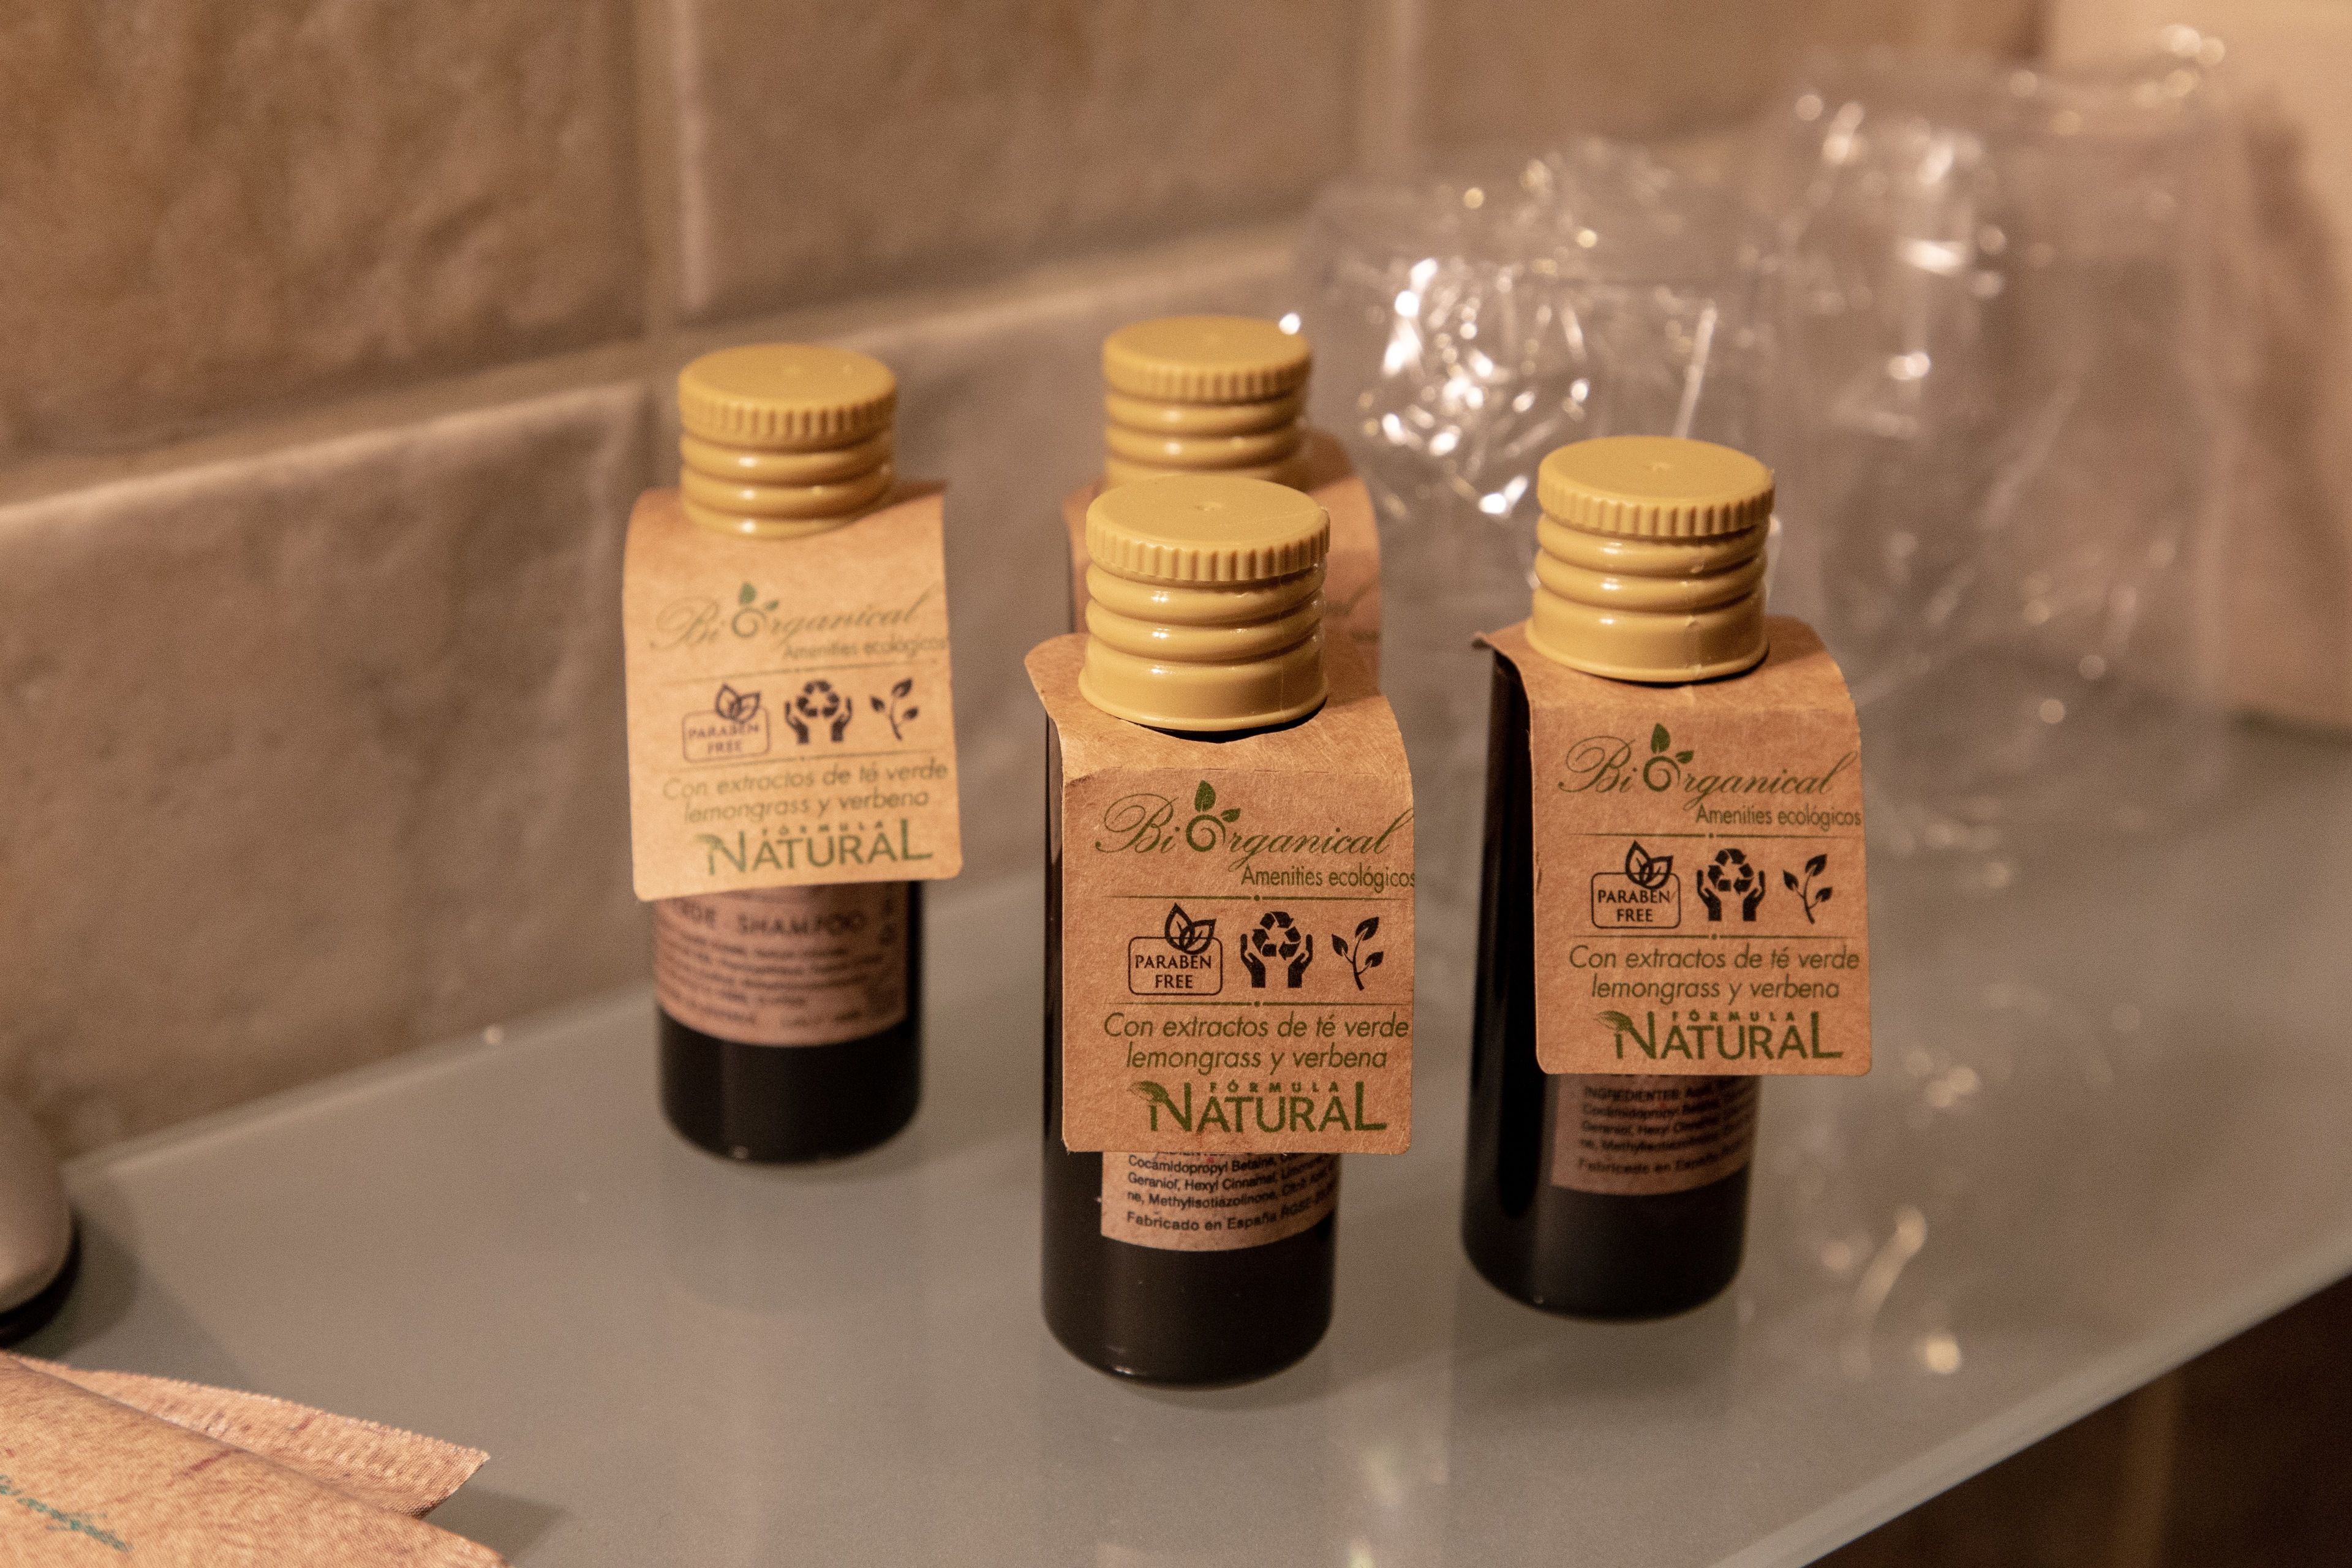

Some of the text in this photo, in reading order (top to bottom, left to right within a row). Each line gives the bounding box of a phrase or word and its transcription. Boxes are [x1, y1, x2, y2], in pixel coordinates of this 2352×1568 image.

[688, 722, 759, 739] PARABEN
[707, 740, 742, 755] FREE
[662, 757, 948, 800] Con extractos de té verde
[684, 786, 929, 824] lemongrass y verbena
[1695, 803, 1861, 832] Amenities ecológicos
[694, 818, 933, 876] NATURAL
[1241, 864, 1415, 892] Amenities ecológicos
[1597, 889, 1670, 904] PARABEN
[1616, 908, 1654, 923] FREE
[1135, 954, 1212, 970] PARABEN
[1569, 943, 1860, 969] Con extractos de té verde
[1155, 974, 1193, 989] FREE
[1591, 973, 1840, 1005] lemongrass y verbena
[1104, 1012, 1409, 1038] Con extractos de té verde
[1672, 1009, 1795, 1022] FÓRMULA
[1594, 1010, 1844, 1060] NATURAL
[1126, 1042, 1387, 1076] lemongrass y verbena
[1209, 1080, 1340, 1093] FÓRMULA
[1127, 1080, 1388, 1133] NATURAL
[1128, 1154, 1227, 1177] Cocamidopropyl
[1185, 1174, 1219, 1194] Hexyl
[1128, 1190, 1145, 1206] ne,
[1127, 1209, 1276, 1232] Fabricado en España
